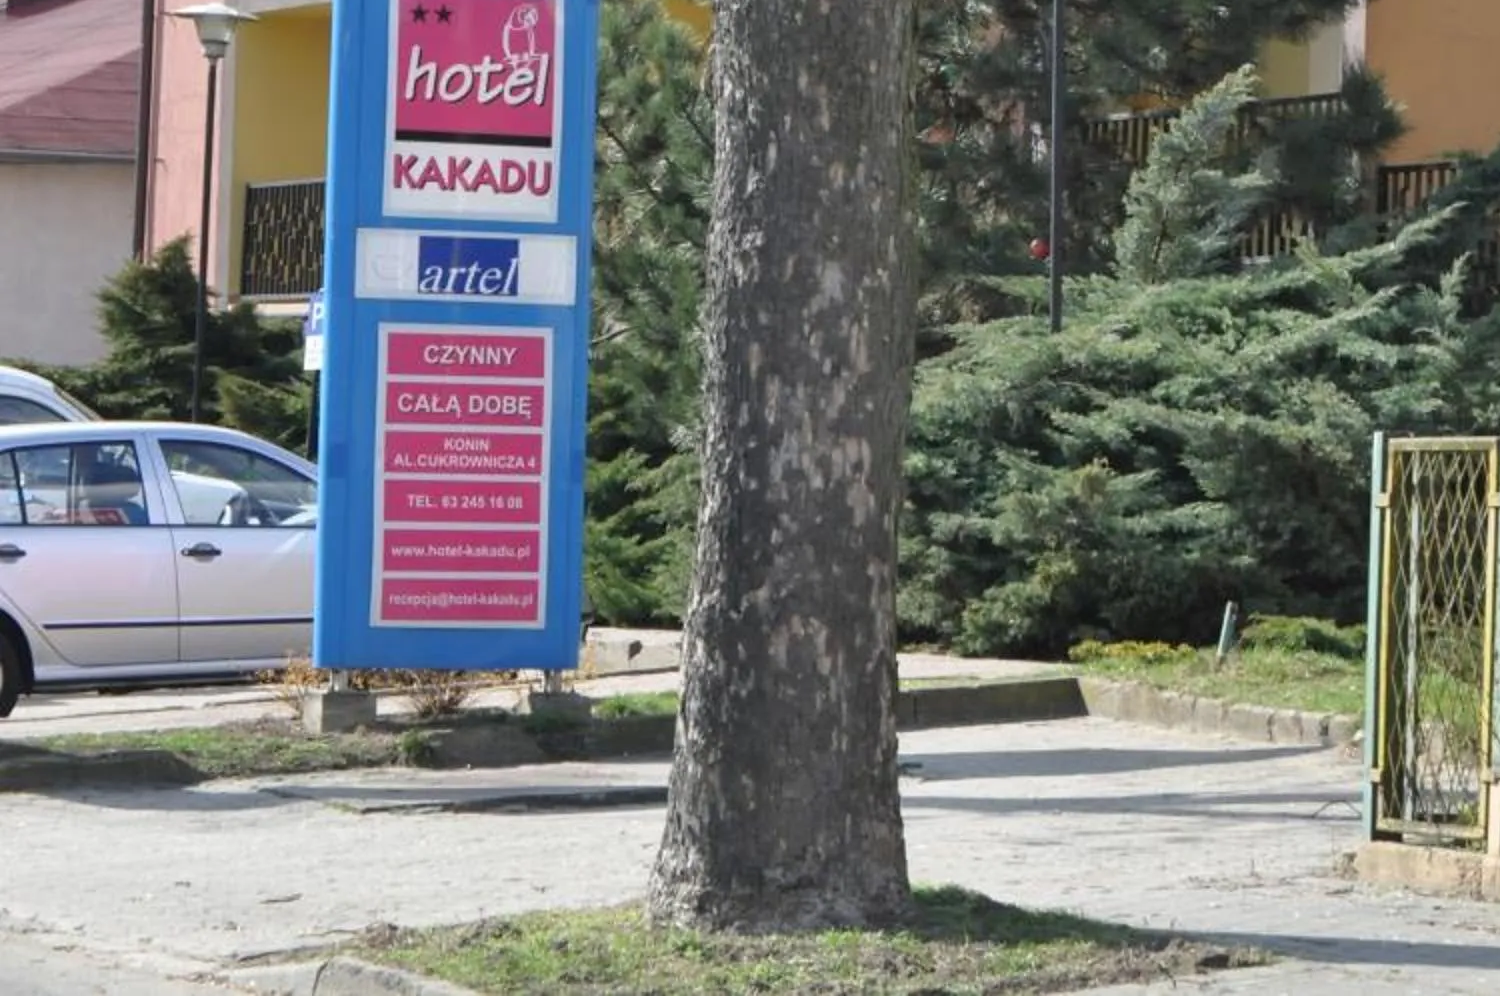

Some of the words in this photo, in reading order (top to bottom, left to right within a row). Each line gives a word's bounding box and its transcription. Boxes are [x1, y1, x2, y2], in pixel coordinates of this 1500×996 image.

[405, 44, 549, 107] hotel
[393, 154, 553, 197] KAKADU
[419, 257, 518, 295] artel
[423, 344, 517, 366] CZYNNY
[397, 393, 462, 419] CAŁĄ
[468, 394, 533, 419] DOBĘ
[444, 437, 491, 452] KONIN
[394, 453, 525, 469] AL.CUKROWNICZA
[527, 456, 536, 469] 4
[407, 494, 438, 509] TEL.
[441, 494, 457, 509] 63
[391, 543, 531, 561] www.hotel-kakadu.pl
[389, 591, 533, 609] recepcja@hotel-kakadu.pl
